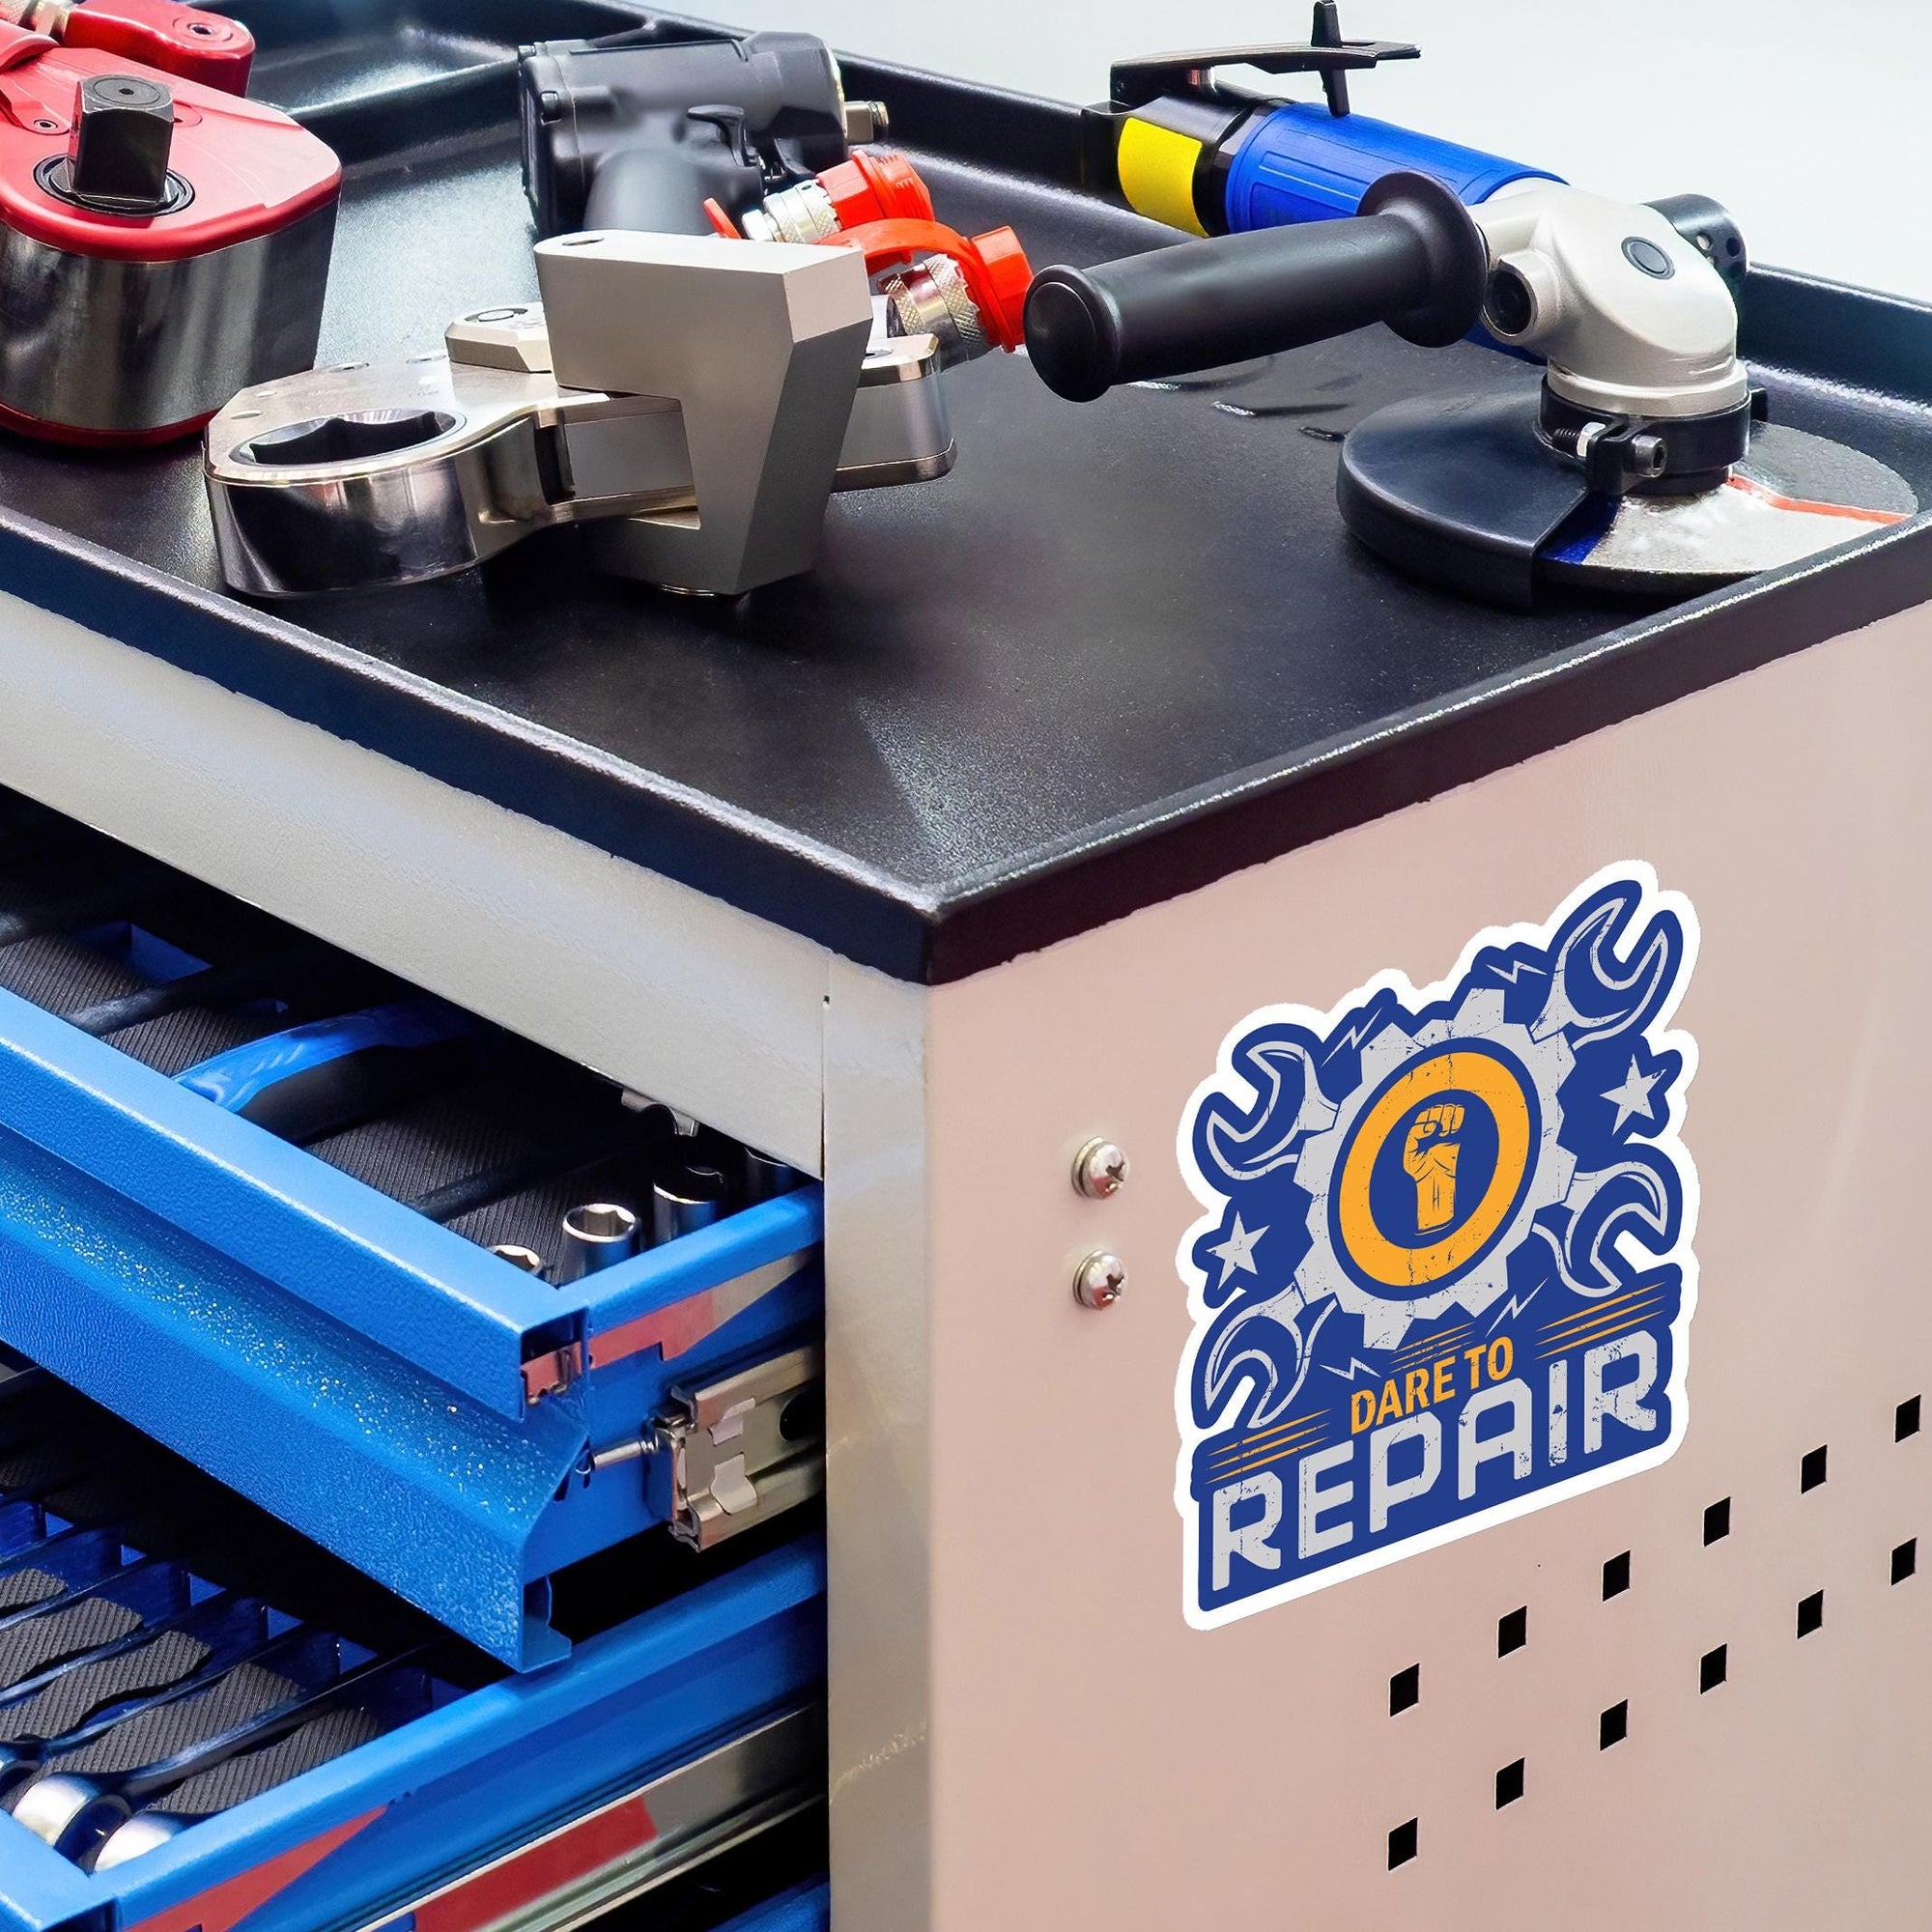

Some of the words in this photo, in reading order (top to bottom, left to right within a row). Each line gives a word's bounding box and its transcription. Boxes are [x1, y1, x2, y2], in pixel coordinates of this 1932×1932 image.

[1212, 1330, 1658, 1592] REPAIR
[1351, 1356, 1456, 1434] DARE
[1463, 1337, 1513, 1391] TO
